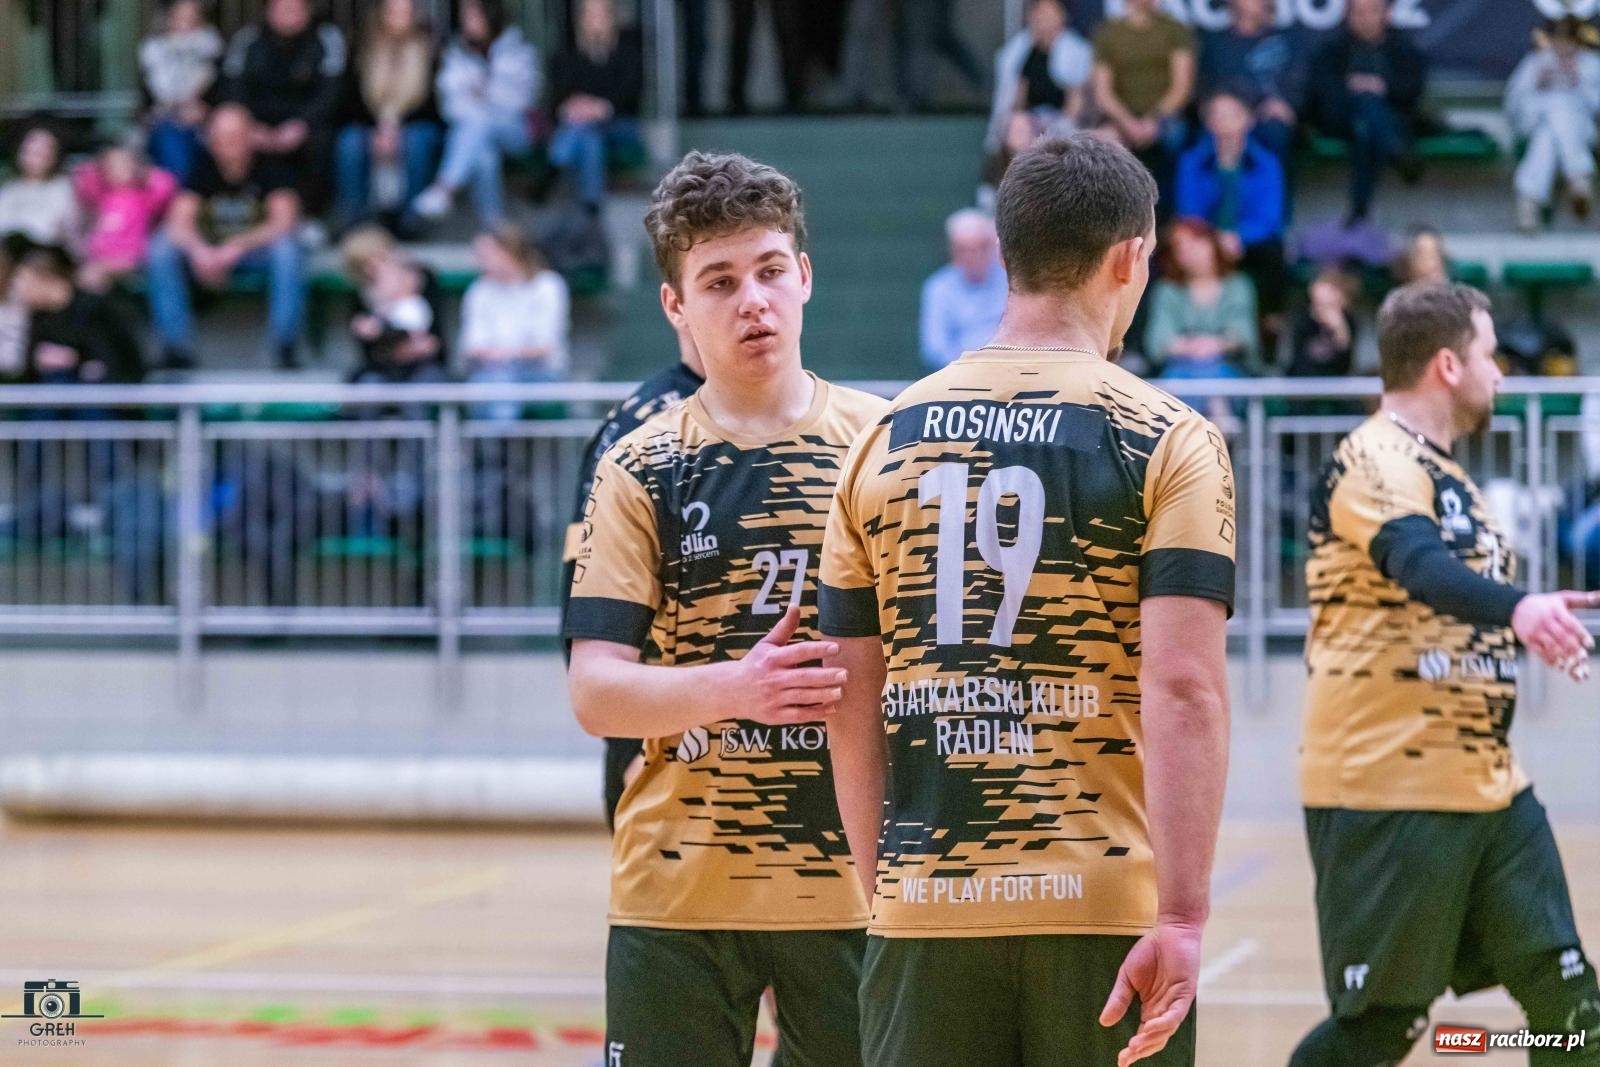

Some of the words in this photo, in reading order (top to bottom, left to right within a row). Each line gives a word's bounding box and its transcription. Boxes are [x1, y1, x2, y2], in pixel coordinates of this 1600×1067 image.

[922, 402, 1062, 443] ROSIŃSKI
[917, 463, 1046, 648] 19
[751, 549, 808, 615] 27
[886, 676, 1024, 718] SIATKARSKI
[1031, 683, 1099, 718] KLUB
[719, 728, 771, 758] JSW
[781, 726, 830, 750] KO
[936, 719, 1034, 757] RADLIN
[902, 876, 928, 903] WE
[933, 876, 986, 903] PLAY
[991, 874, 1032, 901] FOR
[1040, 873, 1083, 900] FUN
